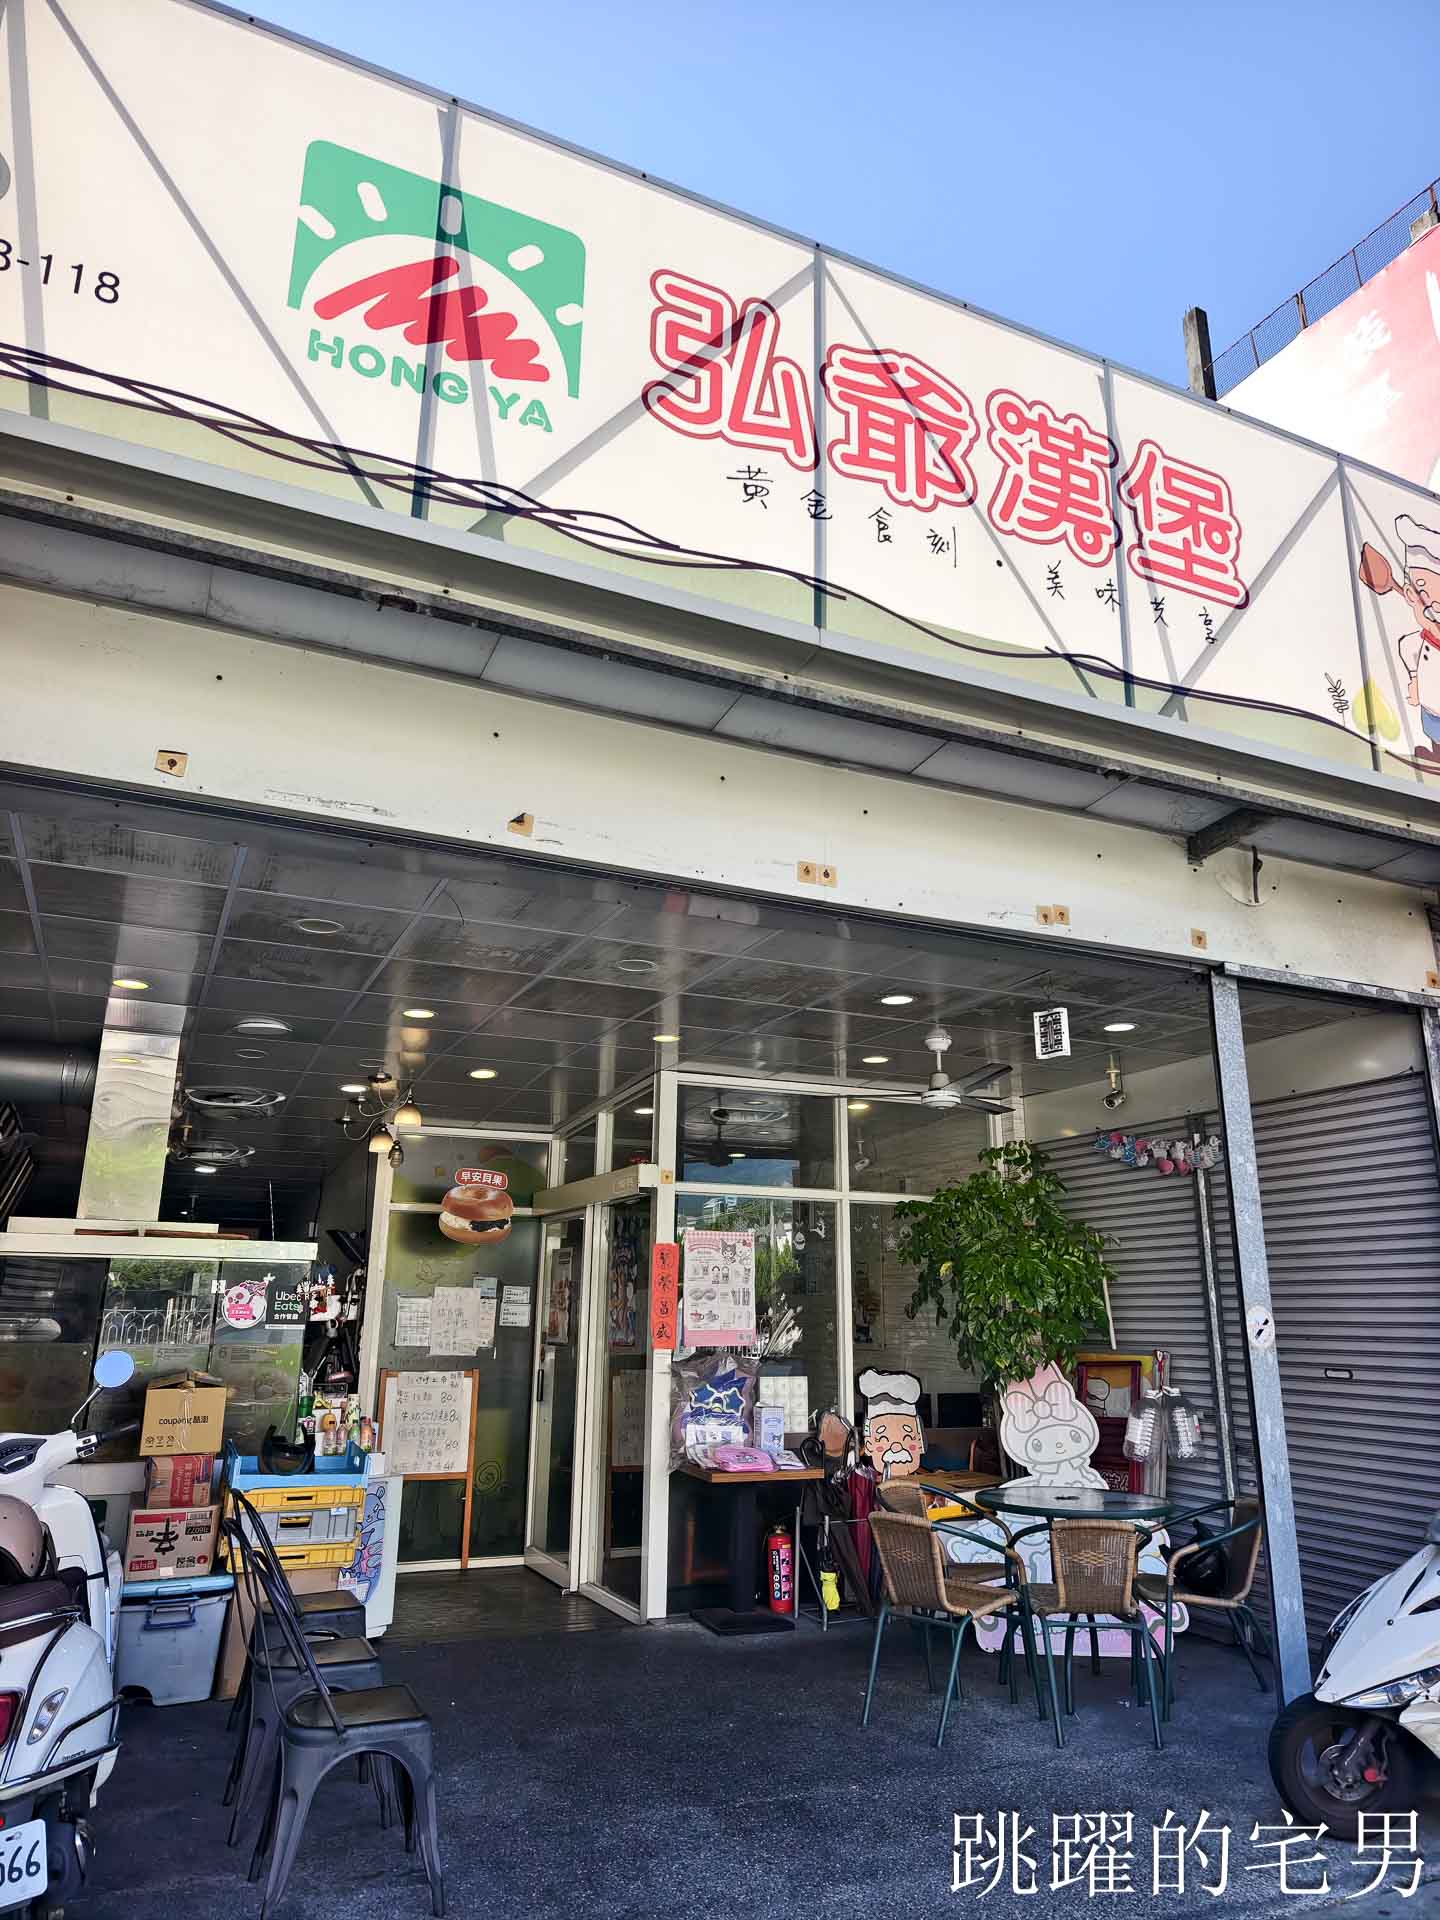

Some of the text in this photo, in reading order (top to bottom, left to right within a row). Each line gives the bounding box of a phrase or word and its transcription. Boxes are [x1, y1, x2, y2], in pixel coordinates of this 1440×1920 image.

[306, 328, 554, 433] HONG YA
[642, 269, 1251, 609] 弘爺漢堡
[461, 1171, 503, 1186] 早安貝果
[274, 1302, 300, 1311] Eats
